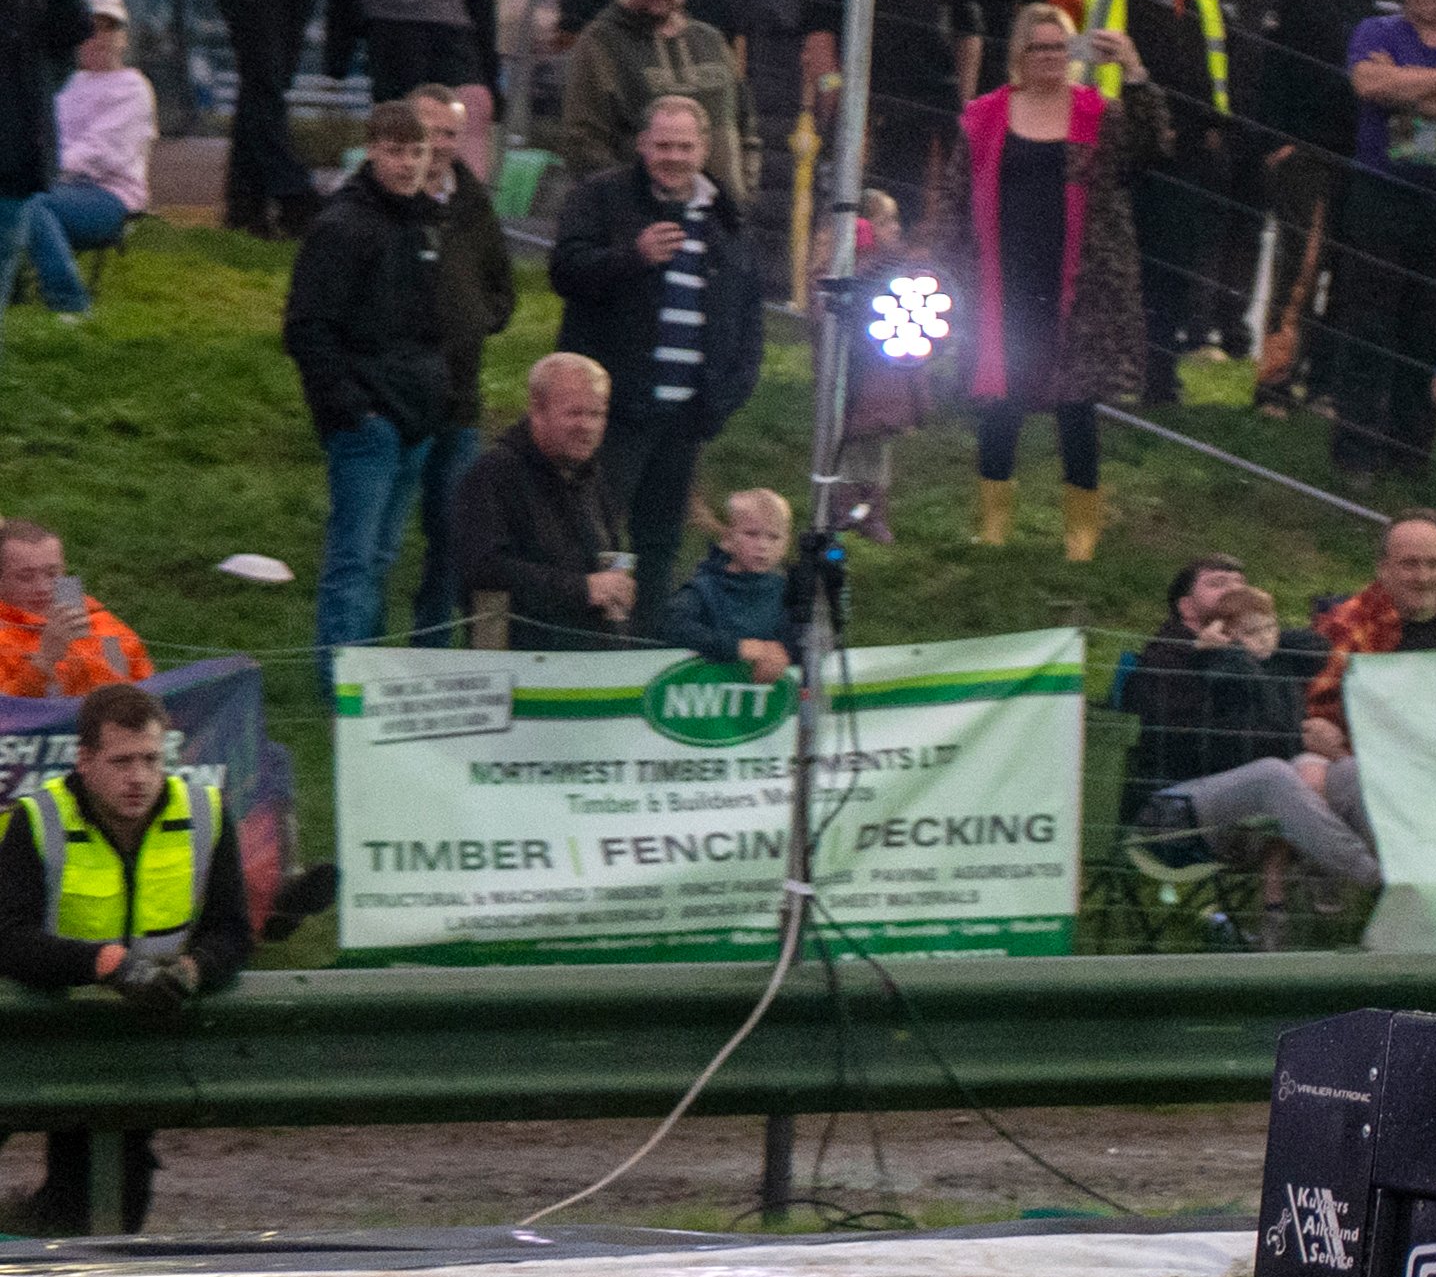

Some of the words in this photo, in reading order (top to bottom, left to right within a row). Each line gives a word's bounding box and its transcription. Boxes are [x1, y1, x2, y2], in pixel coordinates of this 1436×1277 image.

[663, 681, 775, 719] NWTT
[635, 757, 727, 783] TIMBER
[736, 747, 914, 780] TREMENTS
[362, 839, 553, 872] TIMBER
[598, 830, 783, 866] FENCIN
[853, 813, 1056, 852] DECKING
